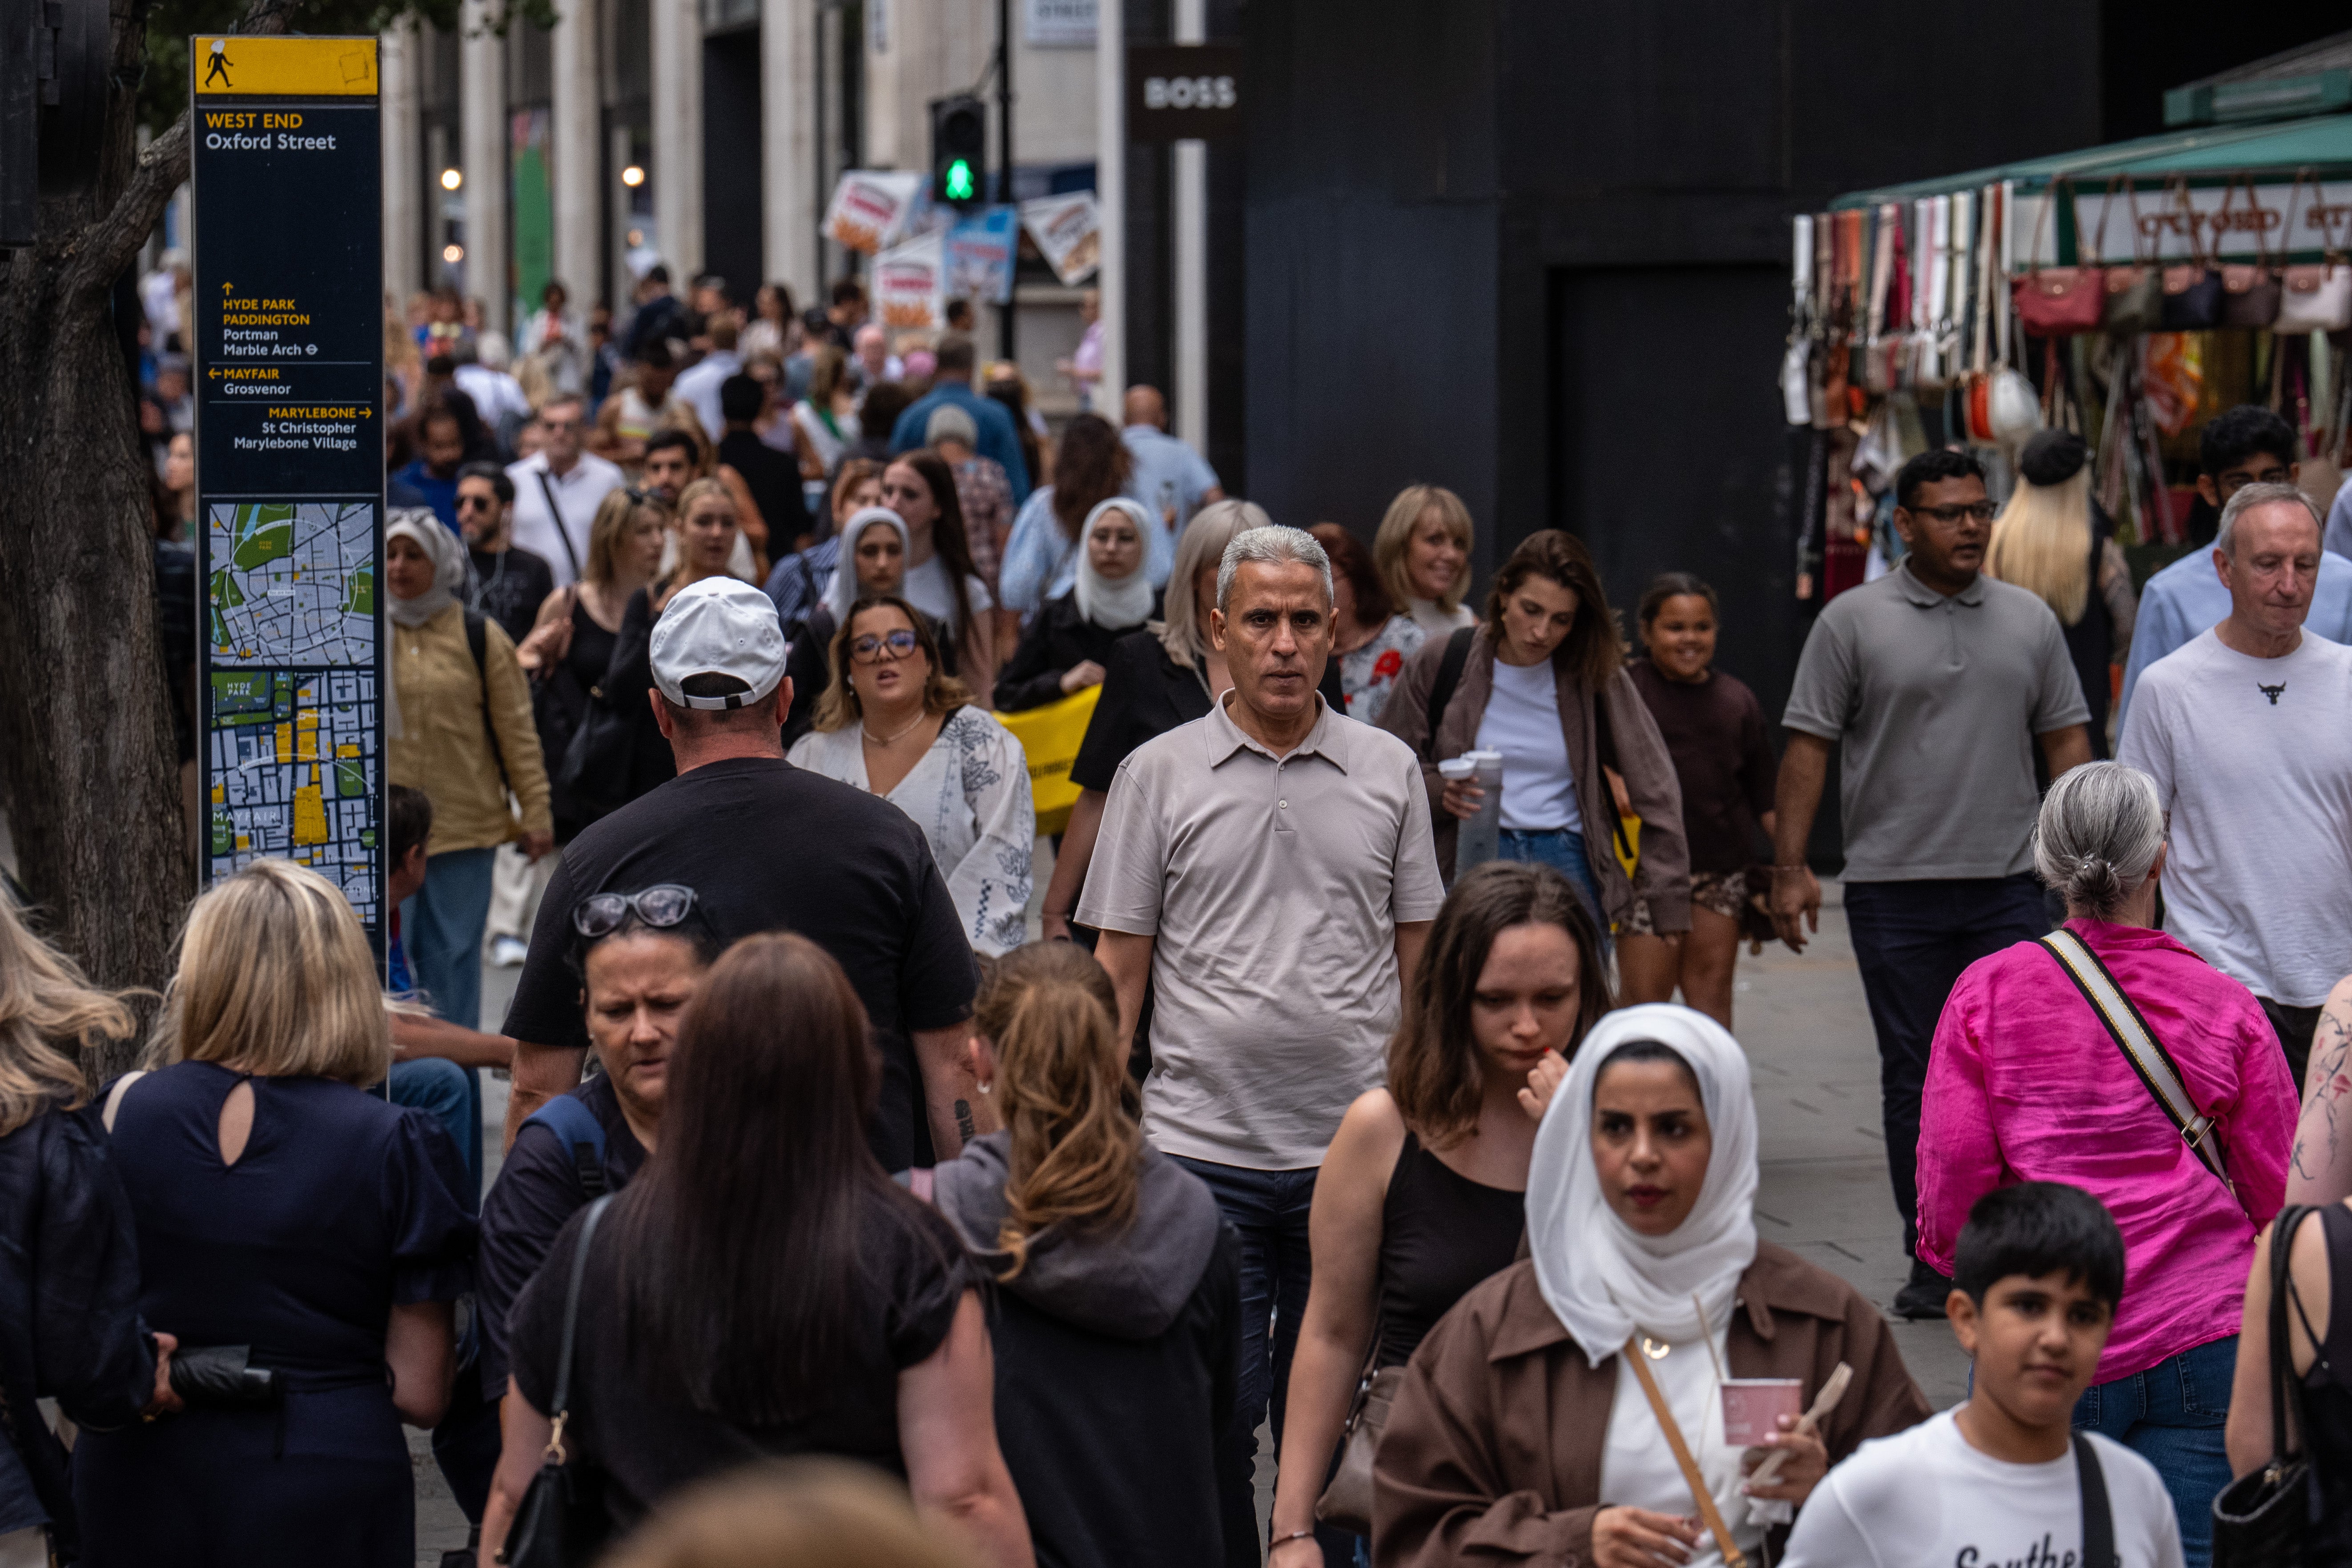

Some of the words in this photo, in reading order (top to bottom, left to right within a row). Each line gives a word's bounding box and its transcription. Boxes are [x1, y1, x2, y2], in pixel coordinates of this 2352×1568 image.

[1145, 76, 1236, 108] BOSS
[205, 113, 257, 128] WEST
[263, 113, 303, 128] END
[206, 132, 271, 149] Oxford
[277, 133, 336, 150] Street
[223, 299, 258, 310] HYDE
[262, 299, 295, 310] PARK
[223, 314, 310, 325] PADDINGTON
[224, 329, 278, 341] Portman
[224, 344, 268, 356] Marble
[272, 344, 302, 356] Arch
[224, 369, 279, 379] MAYFAIR
[224, 383, 291, 395] Grosvenor
[269, 407, 356, 418] MARYLEBONE
[262, 422, 276, 433] St
[279, 421, 356, 436] Christopher
[234, 437, 309, 451] Marylebone
[313, 437, 357, 451] Village
[213, 812, 277, 822] MAYFAIR
